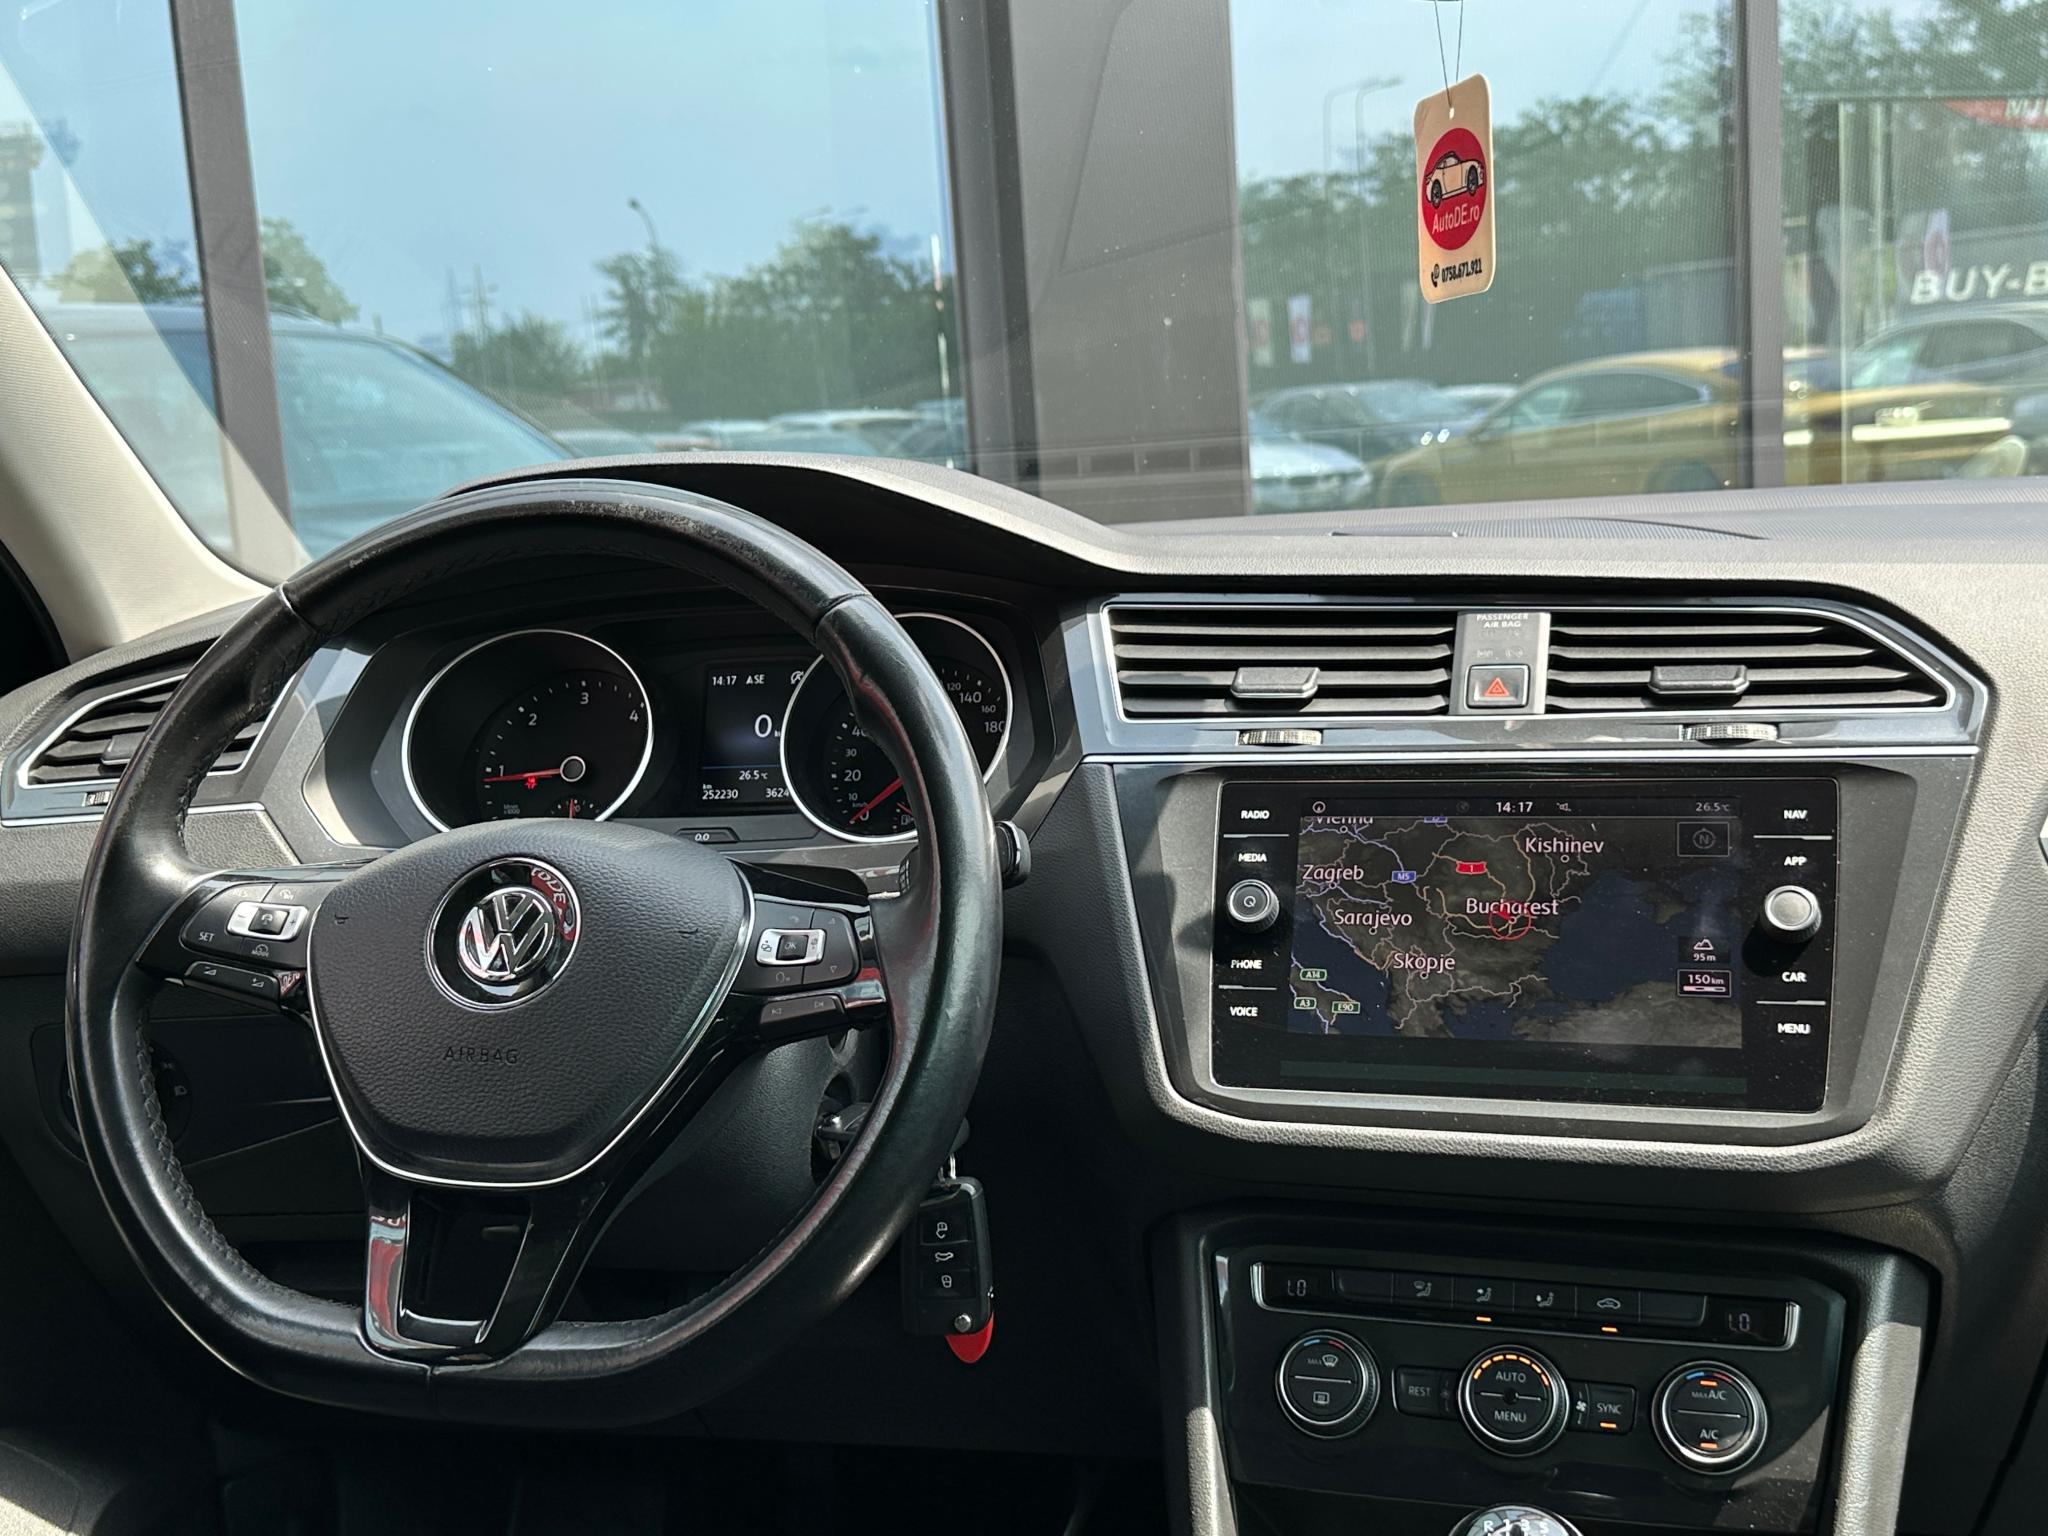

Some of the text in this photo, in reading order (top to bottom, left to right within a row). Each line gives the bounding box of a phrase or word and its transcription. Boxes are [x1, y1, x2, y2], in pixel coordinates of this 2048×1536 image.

[1432, 203, 1480, 235] AutoDE.ro
[1476, 613, 1528, 621] PASSENGER
[712, 675, 737, 686] 14:17
[947, 682, 961, 691] 120
[580, 692, 589, 705] 3
[959, 692, 982, 704] 140
[981, 704, 996, 714] 160
[528, 714, 538, 726] 2
[629, 710, 639, 722] 4
[754, 714, 773, 738] 0
[846, 748, 857, 757] 30
[499, 765, 505, 776] 1
[844, 769, 862, 782] 20
[702, 789, 738, 799] 252230
[848, 793, 858, 801] 10
[1496, 802, 1533, 813] 14:17
[1241, 810, 1270, 819] RADIO
[1784, 809, 1808, 819] NAV
[1525, 837, 1604, 853] Kishinev
[1238, 853, 1267, 862] MEDIA
[1784, 856, 1807, 866] APP
[1302, 865, 1364, 884] Zagreb
[1397, 873, 1409, 881] M5
[1466, 897, 1558, 915] Bucharest
[1334, 909, 1412, 929] Sarajevo
[199, 931, 214, 942] SET
[784, 941, 797, 950] OK
[1230, 959, 1262, 969] PHONE
[1393, 953, 1456, 971] Skopje
[1306, 970, 1321, 979] A14
[1782, 972, 1807, 982] CAR
[1300, 999, 1310, 1007] A3
[1338, 1003, 1354, 1012] E90
[1230, 1007, 1258, 1017] VOICE
[1777, 1023, 1811, 1034] MENU
[443, 1047, 519, 1064] AIRBAG
[1495, 1371, 1527, 1383] AUTO
[1408, 1386, 1431, 1397] REST
[1708, 1389, 1727, 1400] A/C
[1597, 1404, 1621, 1415] SYNC
[1494, 1410, 1527, 1423] MENU
[1700, 1428, 1719, 1440] A/C
[1483, 1520, 1494, 1532] R
[1520, 1519, 1530, 1532] 3
